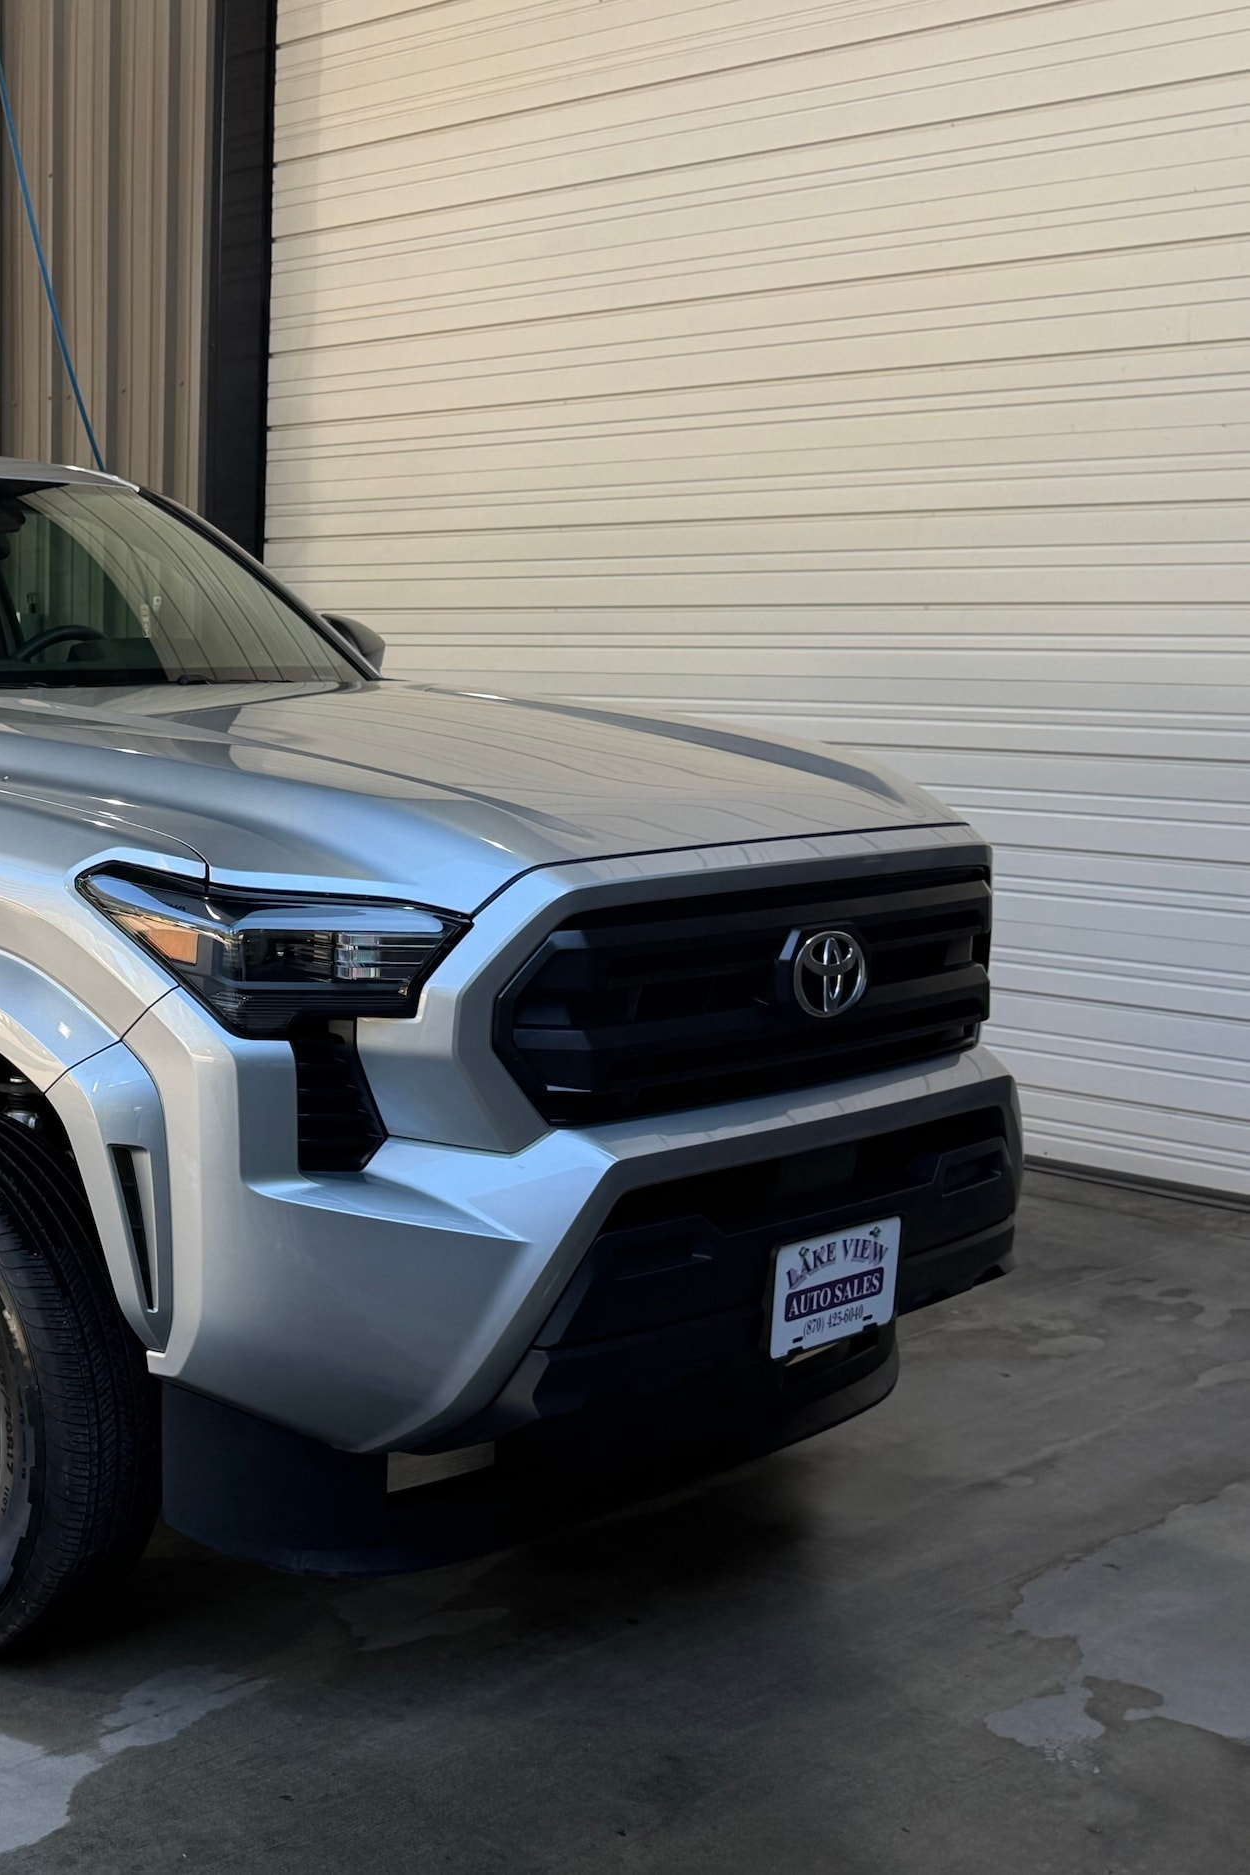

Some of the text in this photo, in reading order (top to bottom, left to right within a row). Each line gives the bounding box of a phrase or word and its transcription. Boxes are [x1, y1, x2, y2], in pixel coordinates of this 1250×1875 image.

[786, 1238, 889, 1290] LAKE VIEW
[788, 1272, 881, 1318] AUTO SALES
[803, 1317, 825, 1338] (870)
